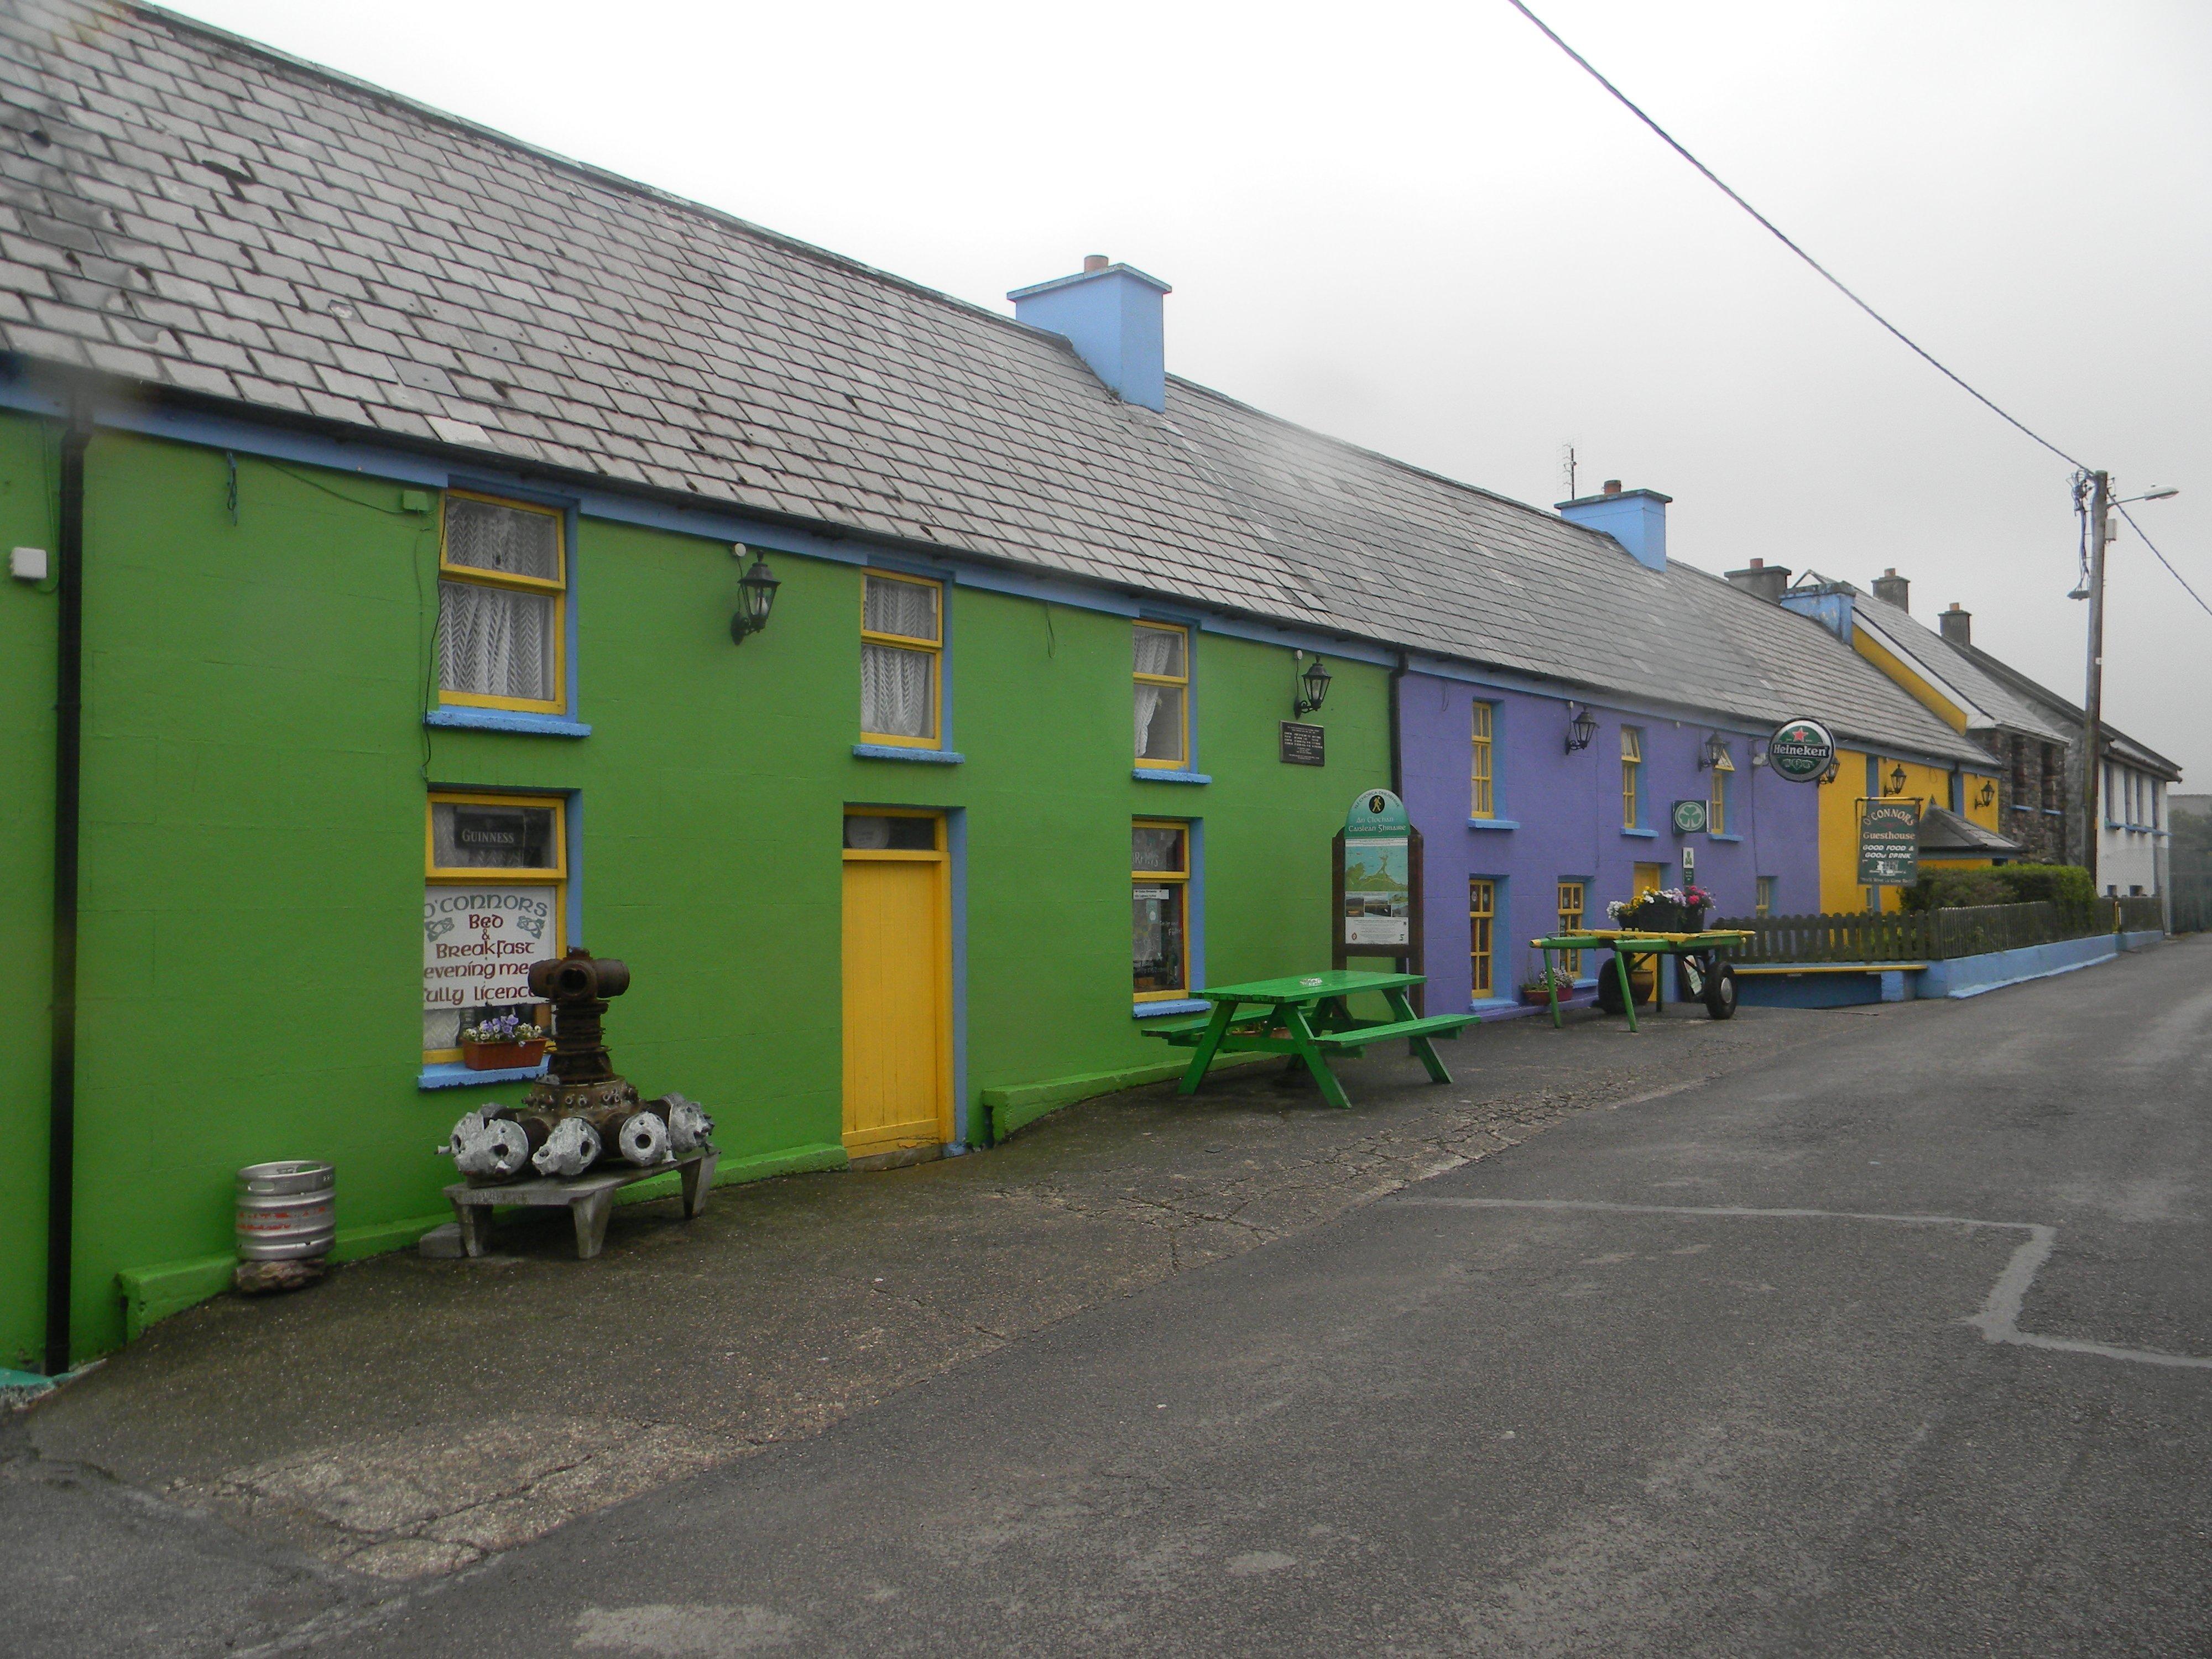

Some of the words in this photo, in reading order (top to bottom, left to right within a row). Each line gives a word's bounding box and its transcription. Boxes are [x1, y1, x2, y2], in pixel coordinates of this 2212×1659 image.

[1773, 744, 1827, 756] Heineken
[1863, 808, 1915, 826] O'CONNORS
[1863, 831, 1916, 839] Guesthouse
[469, 914, 503, 929] Bed
[482, 928, 490, 940] &
[436, 940, 535, 958] Breakfast
[424, 961, 495, 979] evening
[499, 963, 530, 975] me
[474, 985, 535, 1001] licenc
